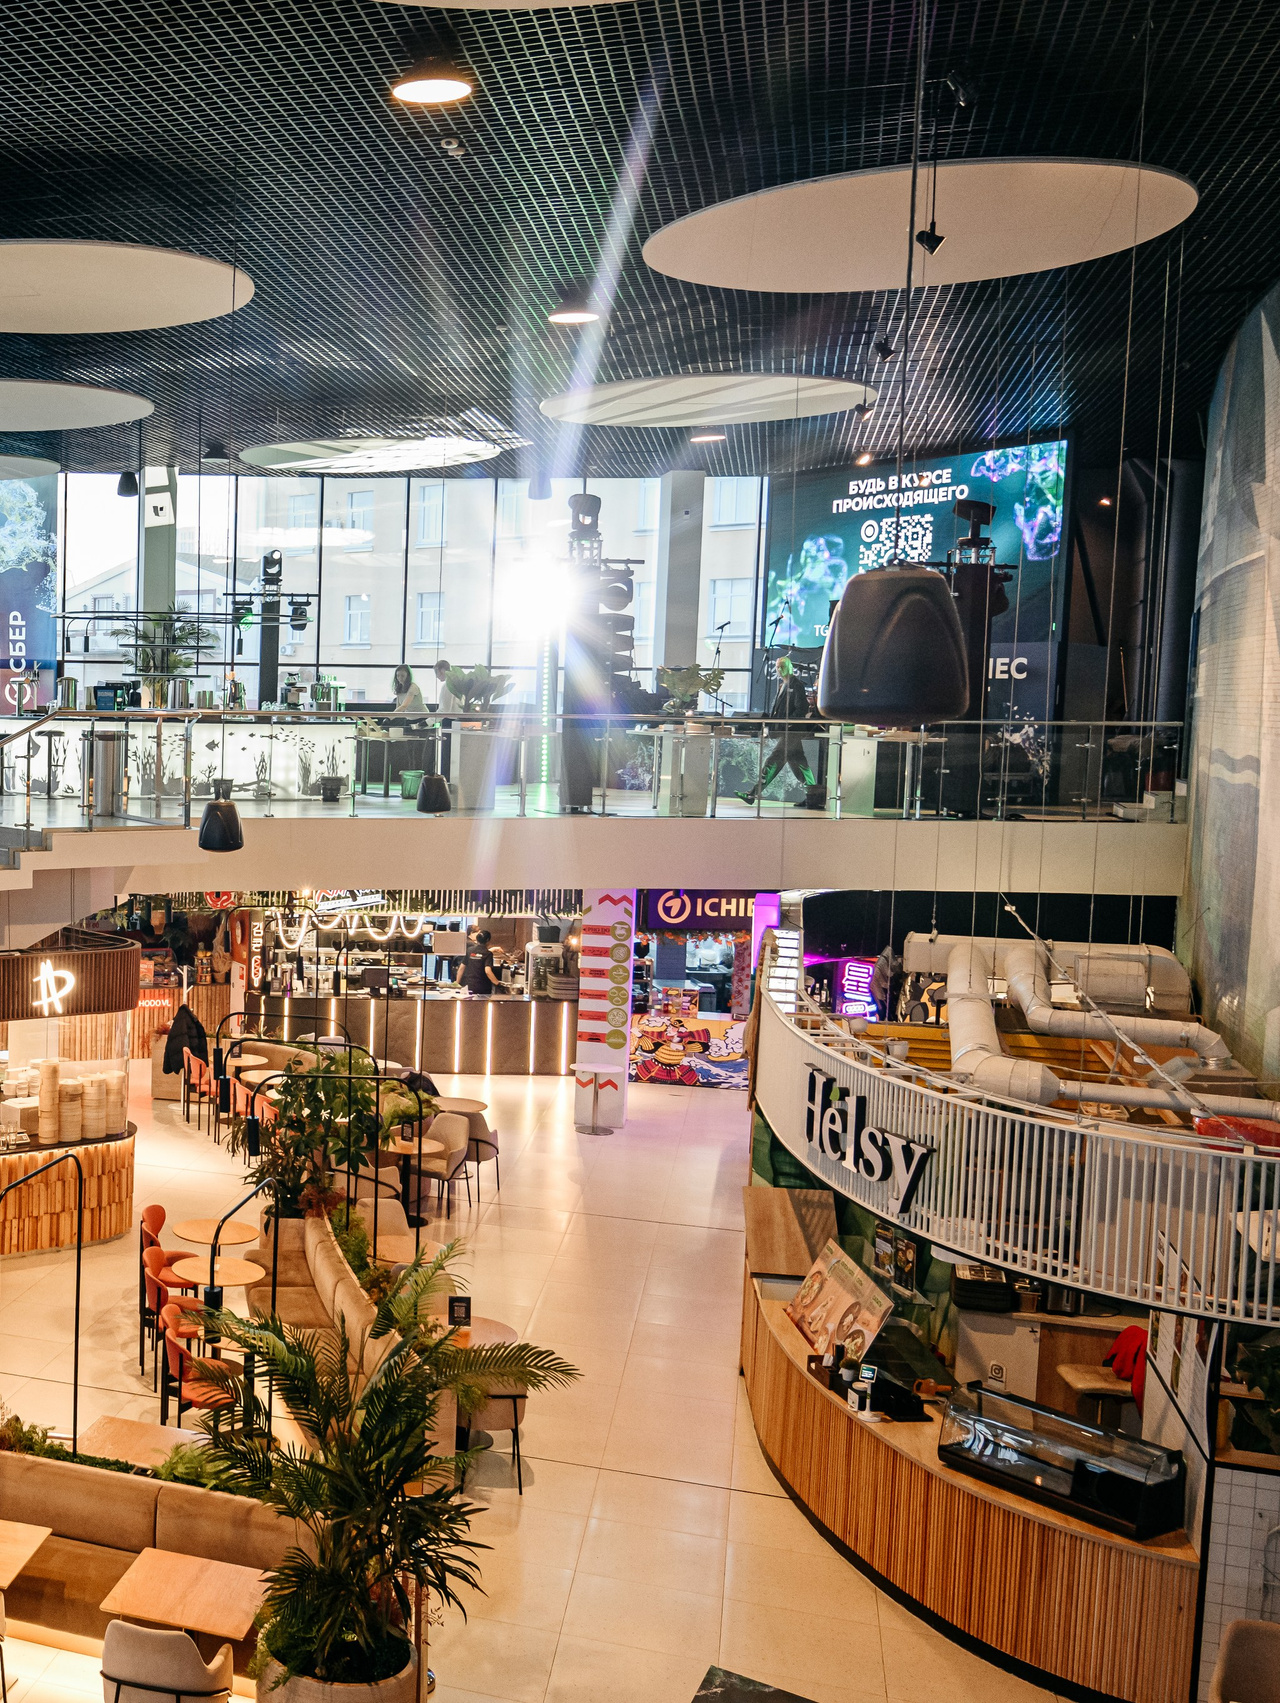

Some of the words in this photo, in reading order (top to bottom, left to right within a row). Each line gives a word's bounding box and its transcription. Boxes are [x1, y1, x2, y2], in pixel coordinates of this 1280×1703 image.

[832, 484, 969, 513] ПРОИСХОДЯЩЕГО
[848, 478, 886, 495] БУДЬ
[888, 476, 898, 490] В
[9, 610, 26, 673] СБЕР
